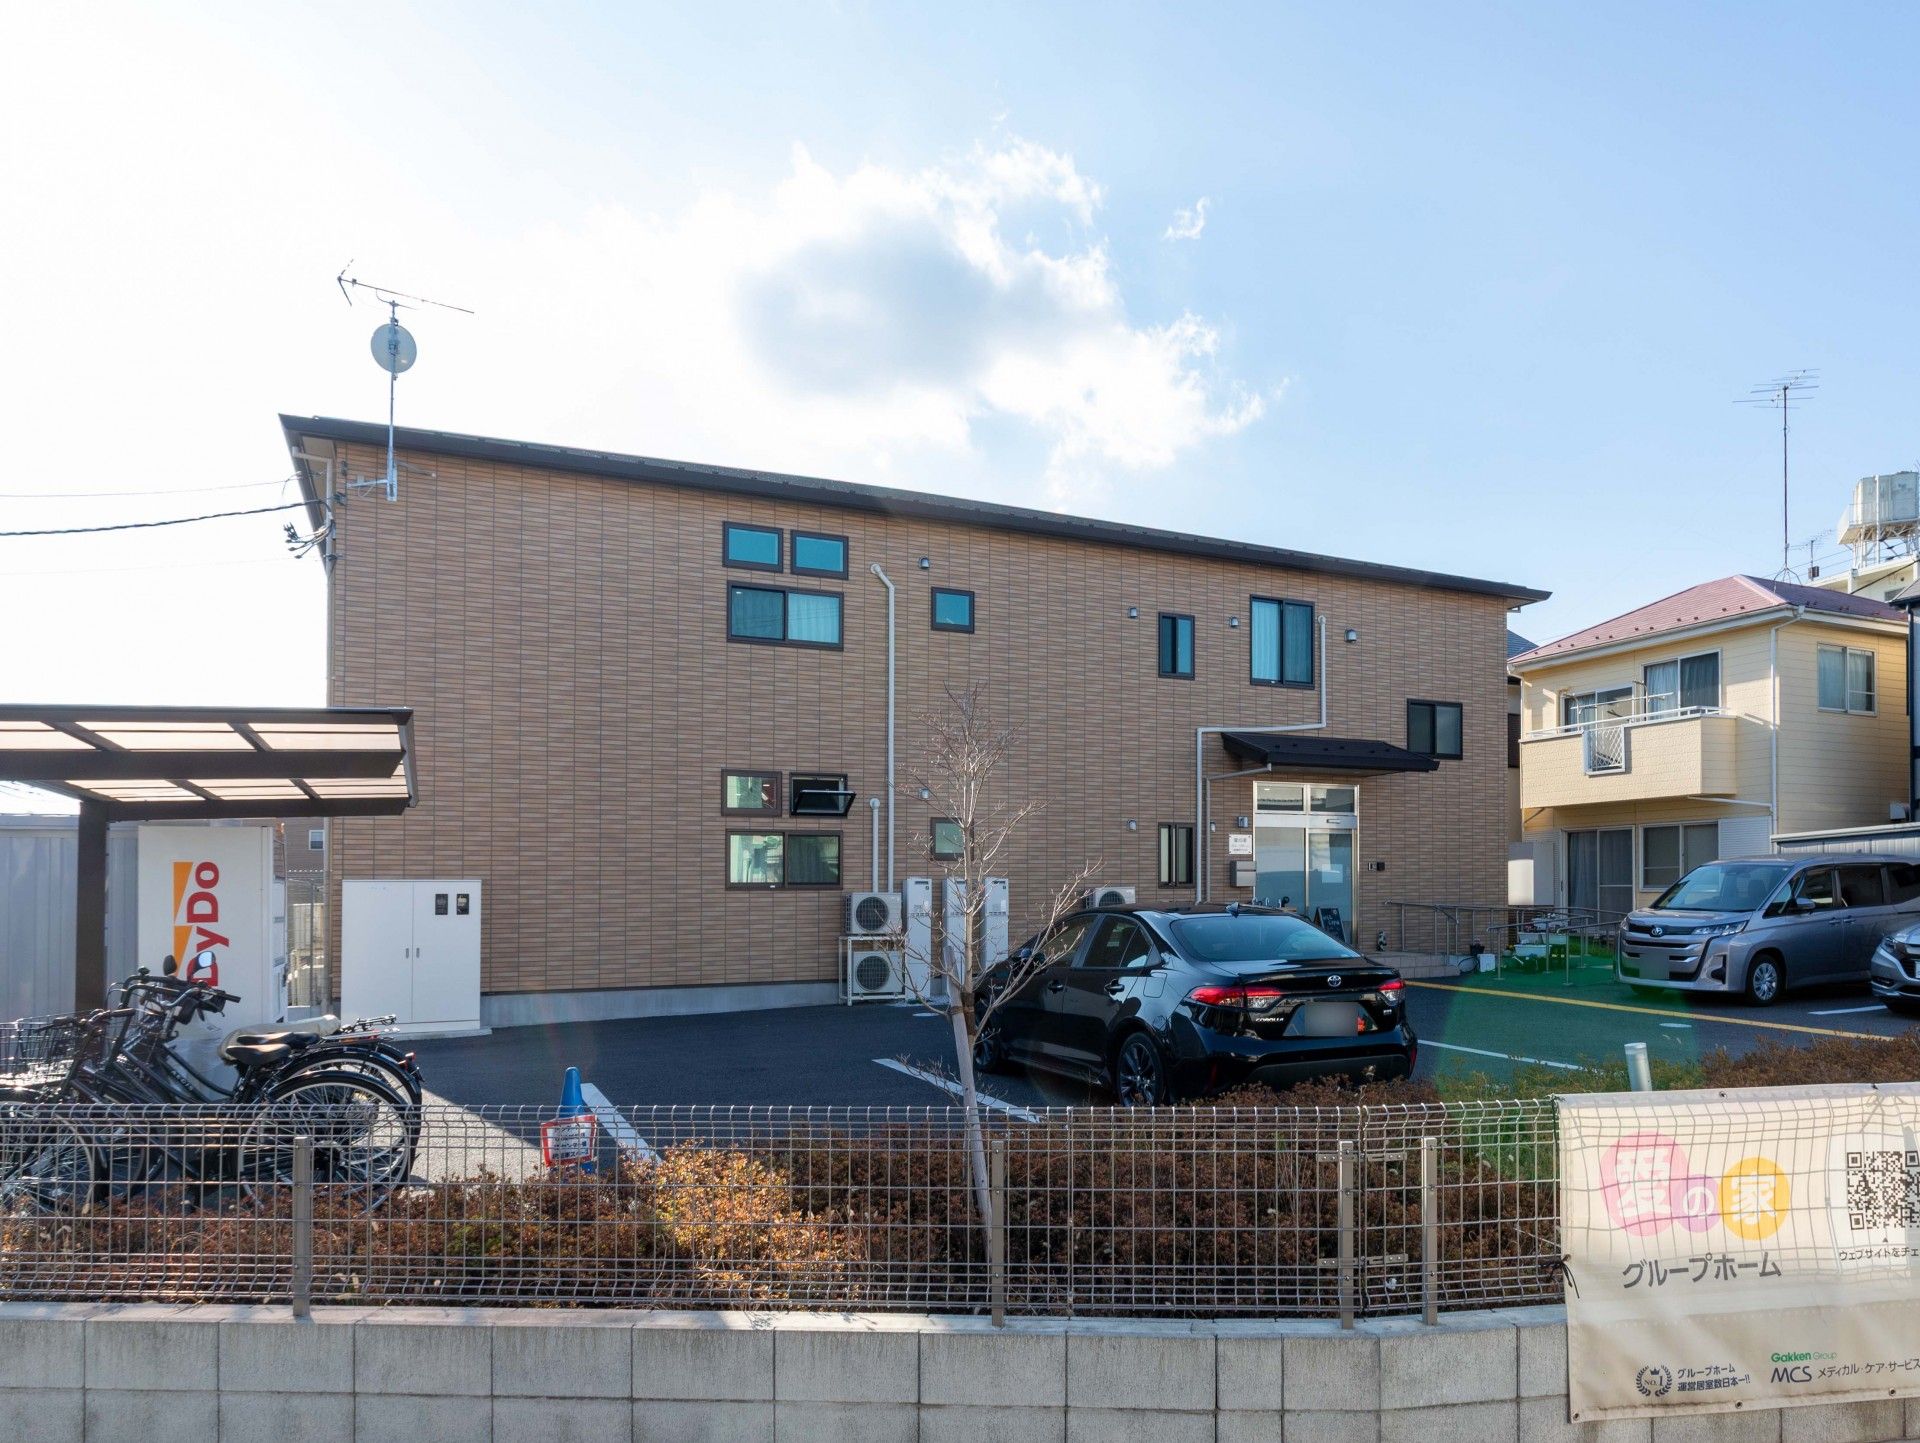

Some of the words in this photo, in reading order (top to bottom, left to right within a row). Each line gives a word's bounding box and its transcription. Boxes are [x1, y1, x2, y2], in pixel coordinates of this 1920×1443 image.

[1616, 1148, 1776, 1225] 愛の家
[1623, 1251, 1782, 1288] グループホーム
[1771, 1352, 1811, 1363] Gakken
[1813, 1351, 1837, 1361] Group
[1677, 1363, 1736, 1379] グループホーム
[1771, 1365, 1812, 1383] MCS
